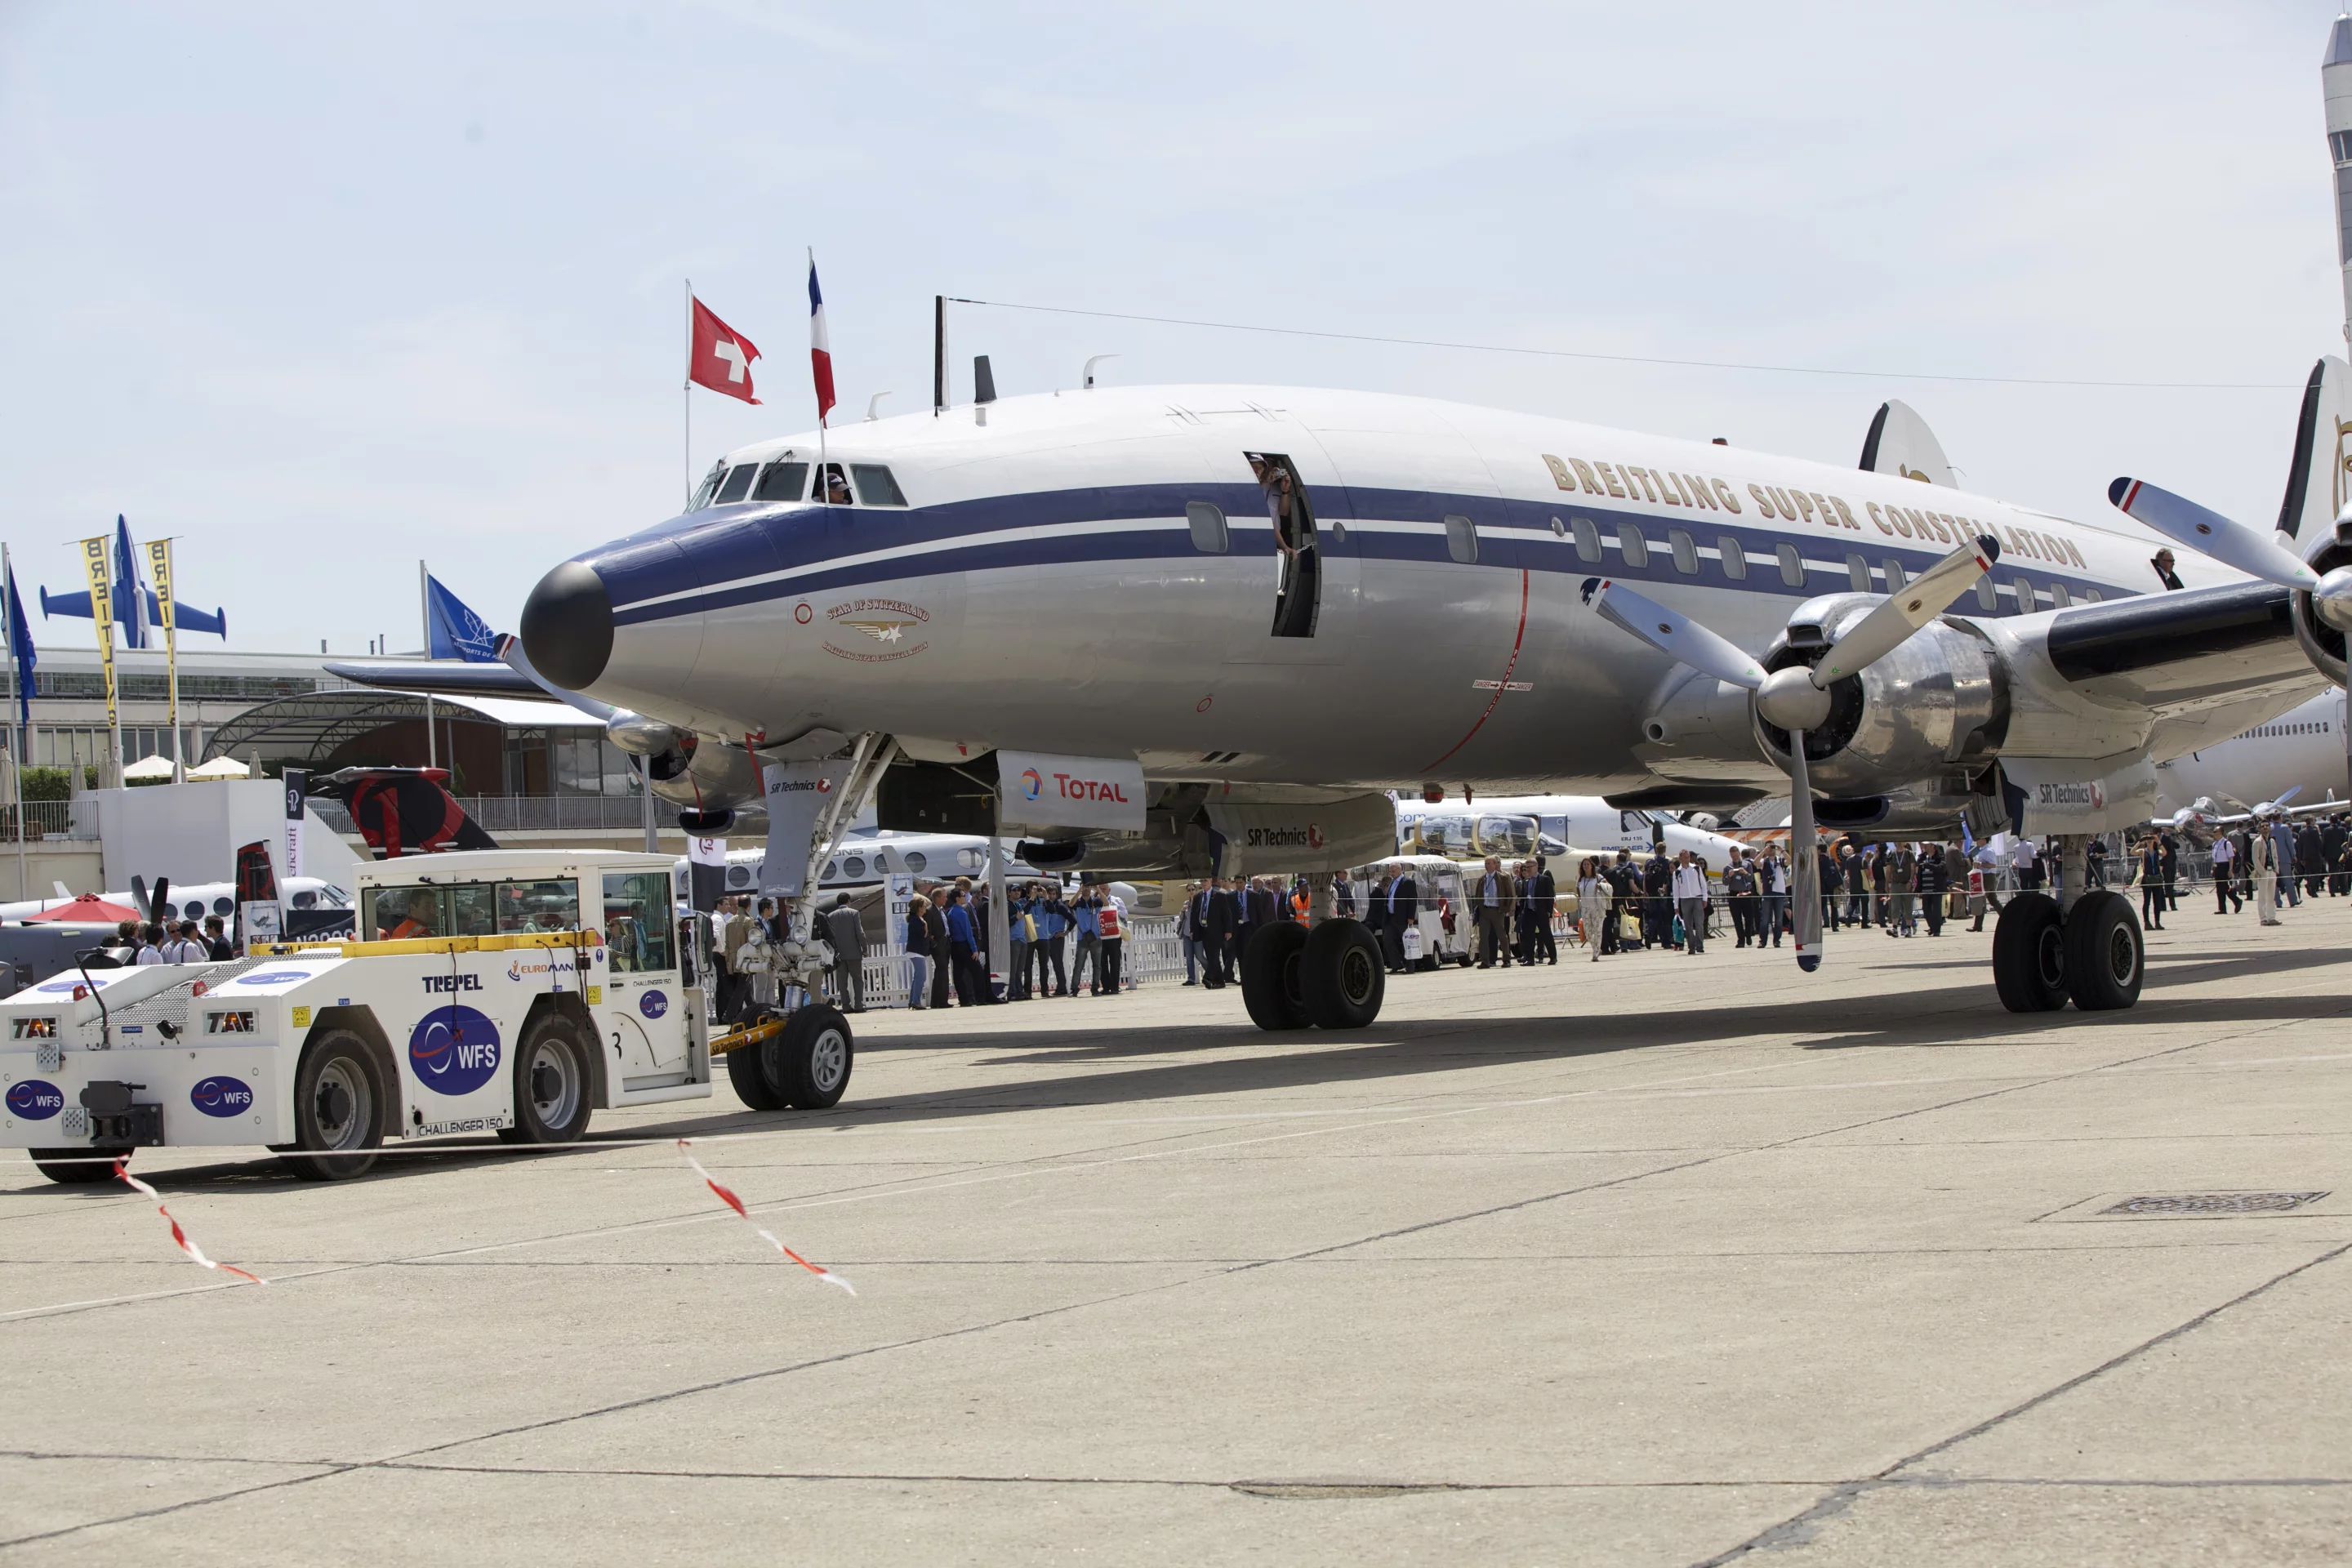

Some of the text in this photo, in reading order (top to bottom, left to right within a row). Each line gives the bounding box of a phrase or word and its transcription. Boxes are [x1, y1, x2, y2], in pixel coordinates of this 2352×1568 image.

[1541, 453, 2087, 570] BREITLING SUPER CONSTELLATION
[826, 599, 930, 622] STAR OF SWITZERLAND
[822, 640, 929, 662] BREITLING SUPER CONSTELLATION
[770, 779, 815, 794] SR Technics
[1053, 773, 1129, 803] TOTAL
[2039, 782, 2090, 804] SR Technics
[1247, 826, 1307, 847] SR Technics
[520, 963, 574, 974] EUROMAN
[421, 973, 483, 994] TREPEL
[633, 979, 662, 987] CHALLENGER
[654, 1002, 667, 1012] WFS
[13, 1018, 57, 1040] TAE
[207, 1011, 254, 1033] TAE
[712, 1037, 744, 1054] SR Technics
[457, 1044, 497, 1069] WFS
[36, 1094, 61, 1107] WFS
[224, 1091, 251, 1104] WFS
[419, 1117, 504, 1137] CHALLENGER 150
